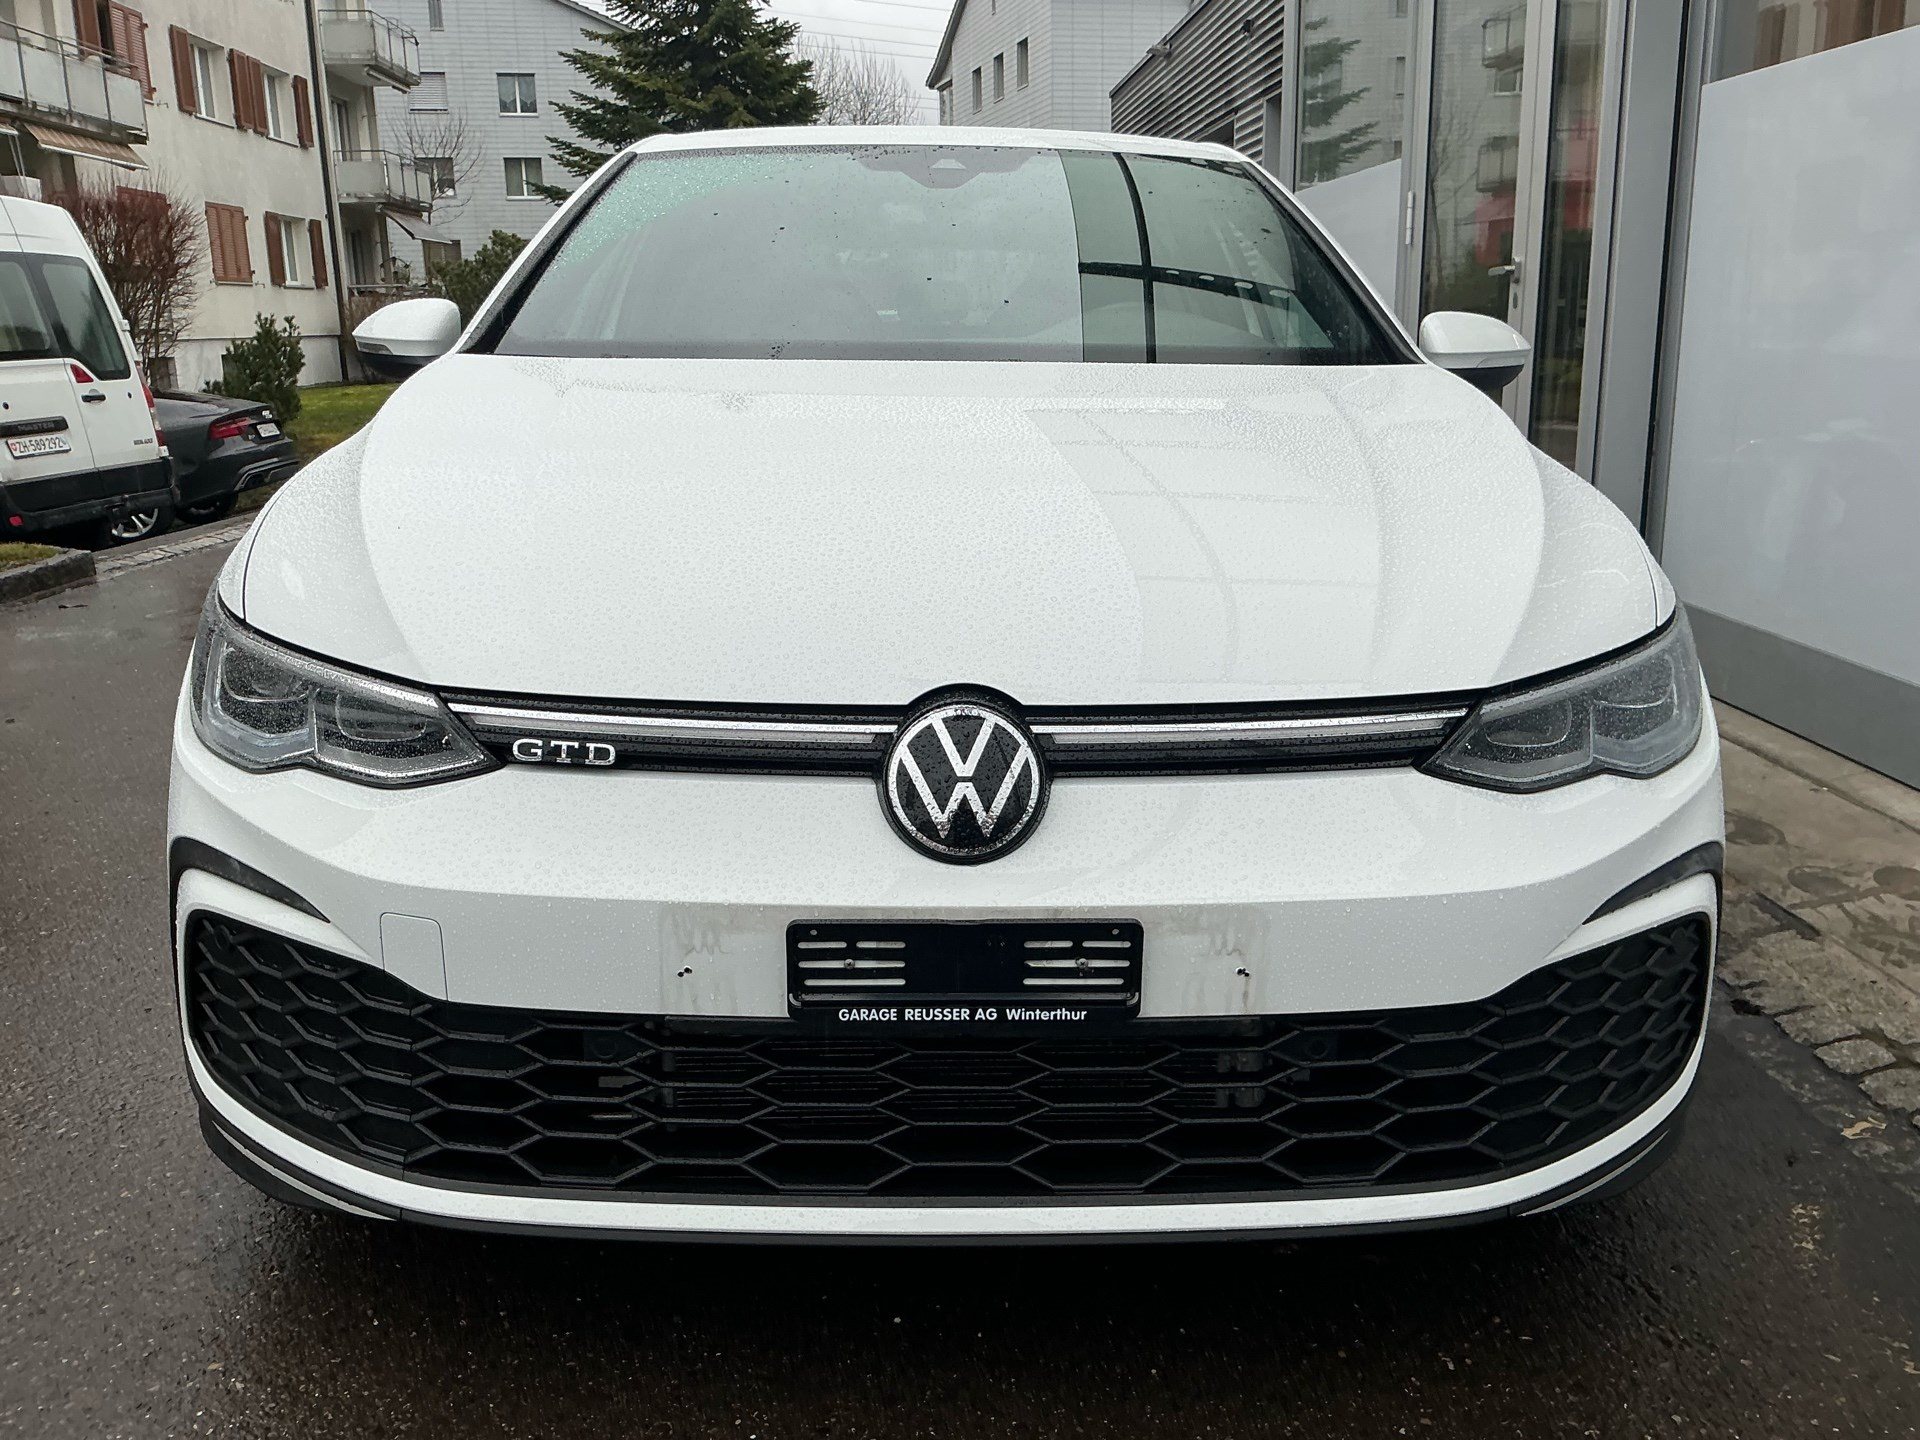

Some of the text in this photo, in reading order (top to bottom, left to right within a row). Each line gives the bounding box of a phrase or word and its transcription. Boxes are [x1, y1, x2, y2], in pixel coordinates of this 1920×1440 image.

[512, 738, 616, 766] GTD
[838, 1008, 1087, 1021] GARAGE REUSSER AG Winterthur
